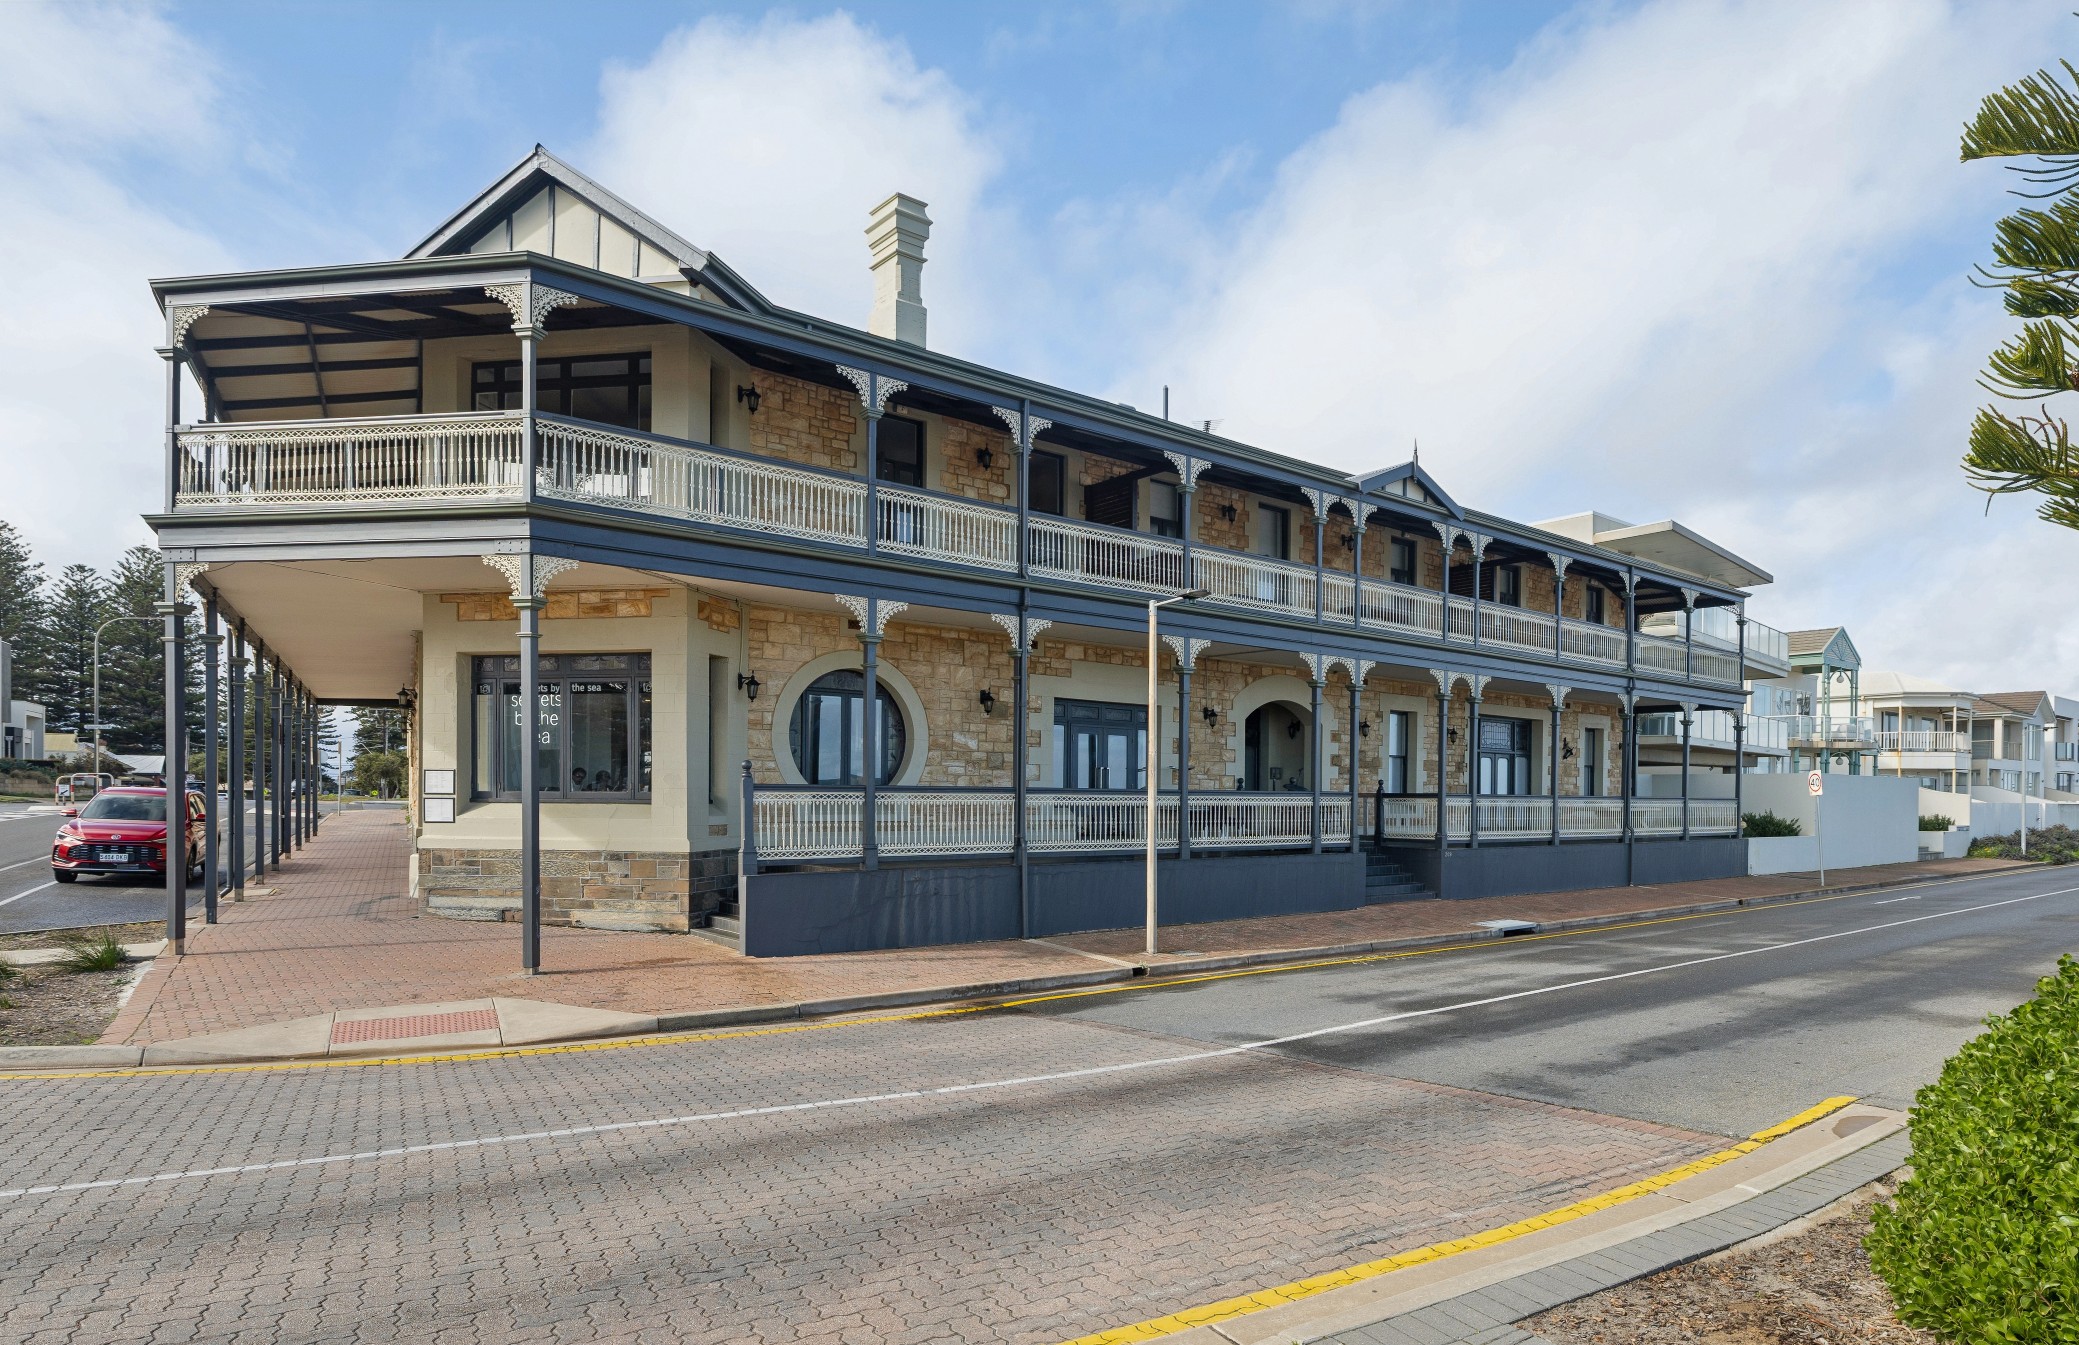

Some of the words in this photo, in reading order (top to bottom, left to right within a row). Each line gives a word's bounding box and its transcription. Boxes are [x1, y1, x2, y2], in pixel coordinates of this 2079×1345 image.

[550, 684, 561, 693] by
[571, 683, 585, 692] the
[587, 684, 602, 692] sea
[538, 711, 558, 726] he
[1811, 777, 1820, 787] 40
